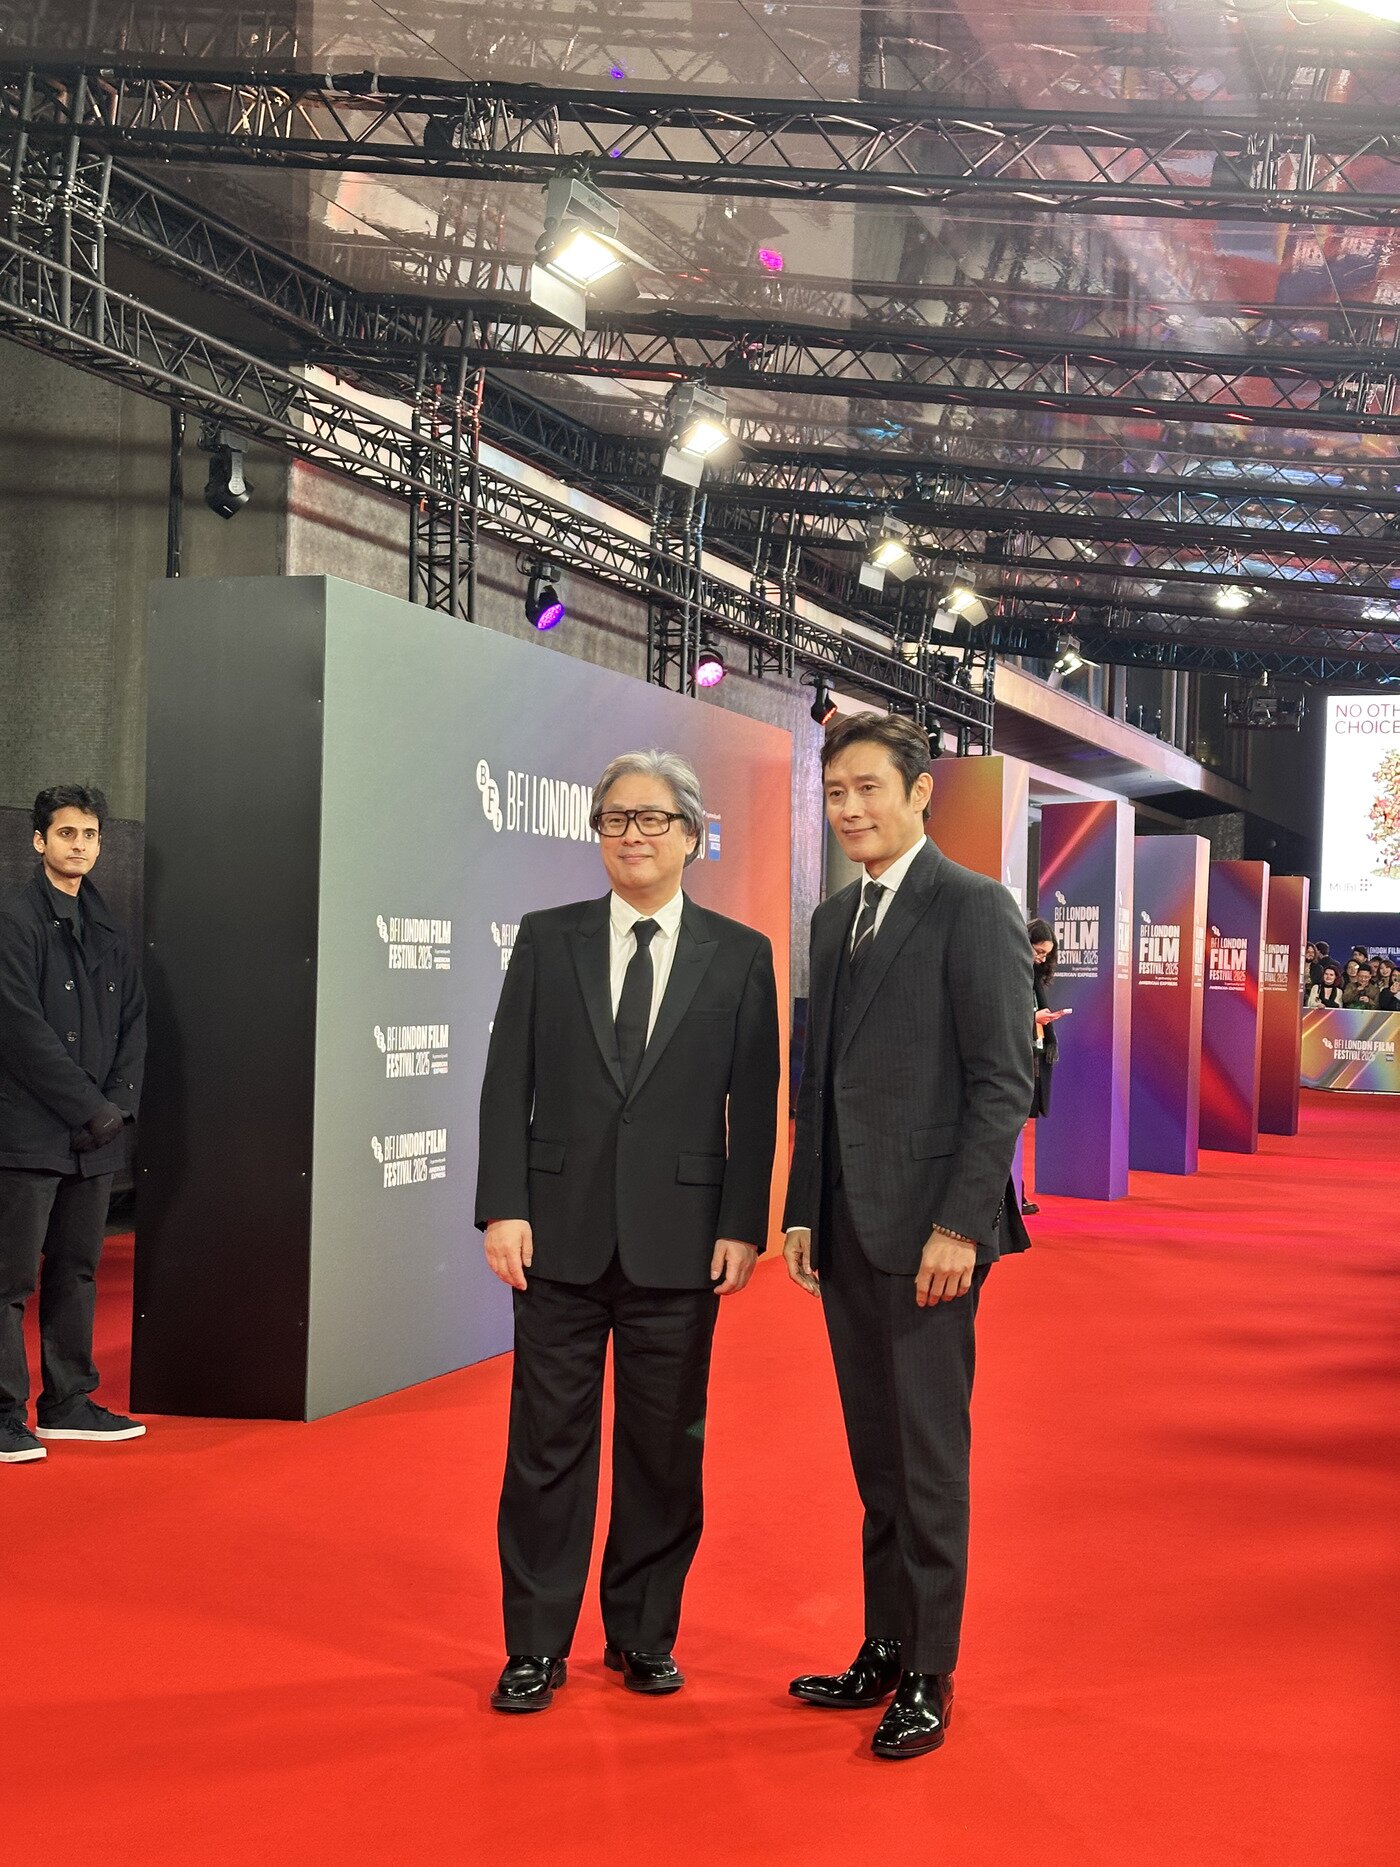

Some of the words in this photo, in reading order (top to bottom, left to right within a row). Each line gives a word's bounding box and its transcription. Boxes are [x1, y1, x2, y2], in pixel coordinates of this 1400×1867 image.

[1336, 704, 1362, 717] NO
[1335, 720, 1400, 734] CHOICE
[507, 770, 529, 833] BFI
[532, 775, 594, 842] LONDON
[1054, 907, 1065, 921] BFI
[1066, 907, 1099, 921] LONDON
[390, 917, 401, 942] BFI
[401, 918, 430, 943] LONDON
[430, 919, 451, 944] FILM
[501, 923, 511, 946] BFI
[1054, 921, 1099, 950] FILM
[1140, 924, 1150, 937] BFI
[1150, 925, 1180, 937] LONDON
[1139, 937, 1180, 962] FILM
[1210, 938, 1220, 949] BFI
[1220, 938, 1247, 949] LONDON
[1367, 946, 1388, 955] LONDON
[389, 944, 417, 969] FESTIVAL
[418, 945, 432, 970] 2025
[1057, 950, 1082, 965] ESTIVAL
[1083, 951, 1098, 965] 2025
[1210, 948, 1247, 971] FILM
[1264, 954, 1289, 973] ILM
[1139, 962, 1165, 975] FESTIVAL
[1165, 962, 1179, 975] 2025
[1209, 970, 1233, 981] FESTIVAL
[387, 1026, 397, 1051] BFI
[398, 1025, 427, 1050] LONDON
[427, 1024, 449, 1049] FILM
[1334, 1038, 1344, 1048] BFI
[1344, 1039, 1373, 1051] LONDON
[1373, 1041, 1395, 1053] FILM
[386, 1052, 415, 1078] FESTIVAL
[415, 1051, 430, 1076] 2025
[1334, 1049, 1361, 1061] FESTIVAL
[384, 1135, 395, 1161] BFI
[395, 1131, 426, 1160] LONDON
[425, 1128, 447, 1155] FILM
[383, 1159, 412, 1188] FESTIVAL
[412, 1157, 428, 1183] 2025
